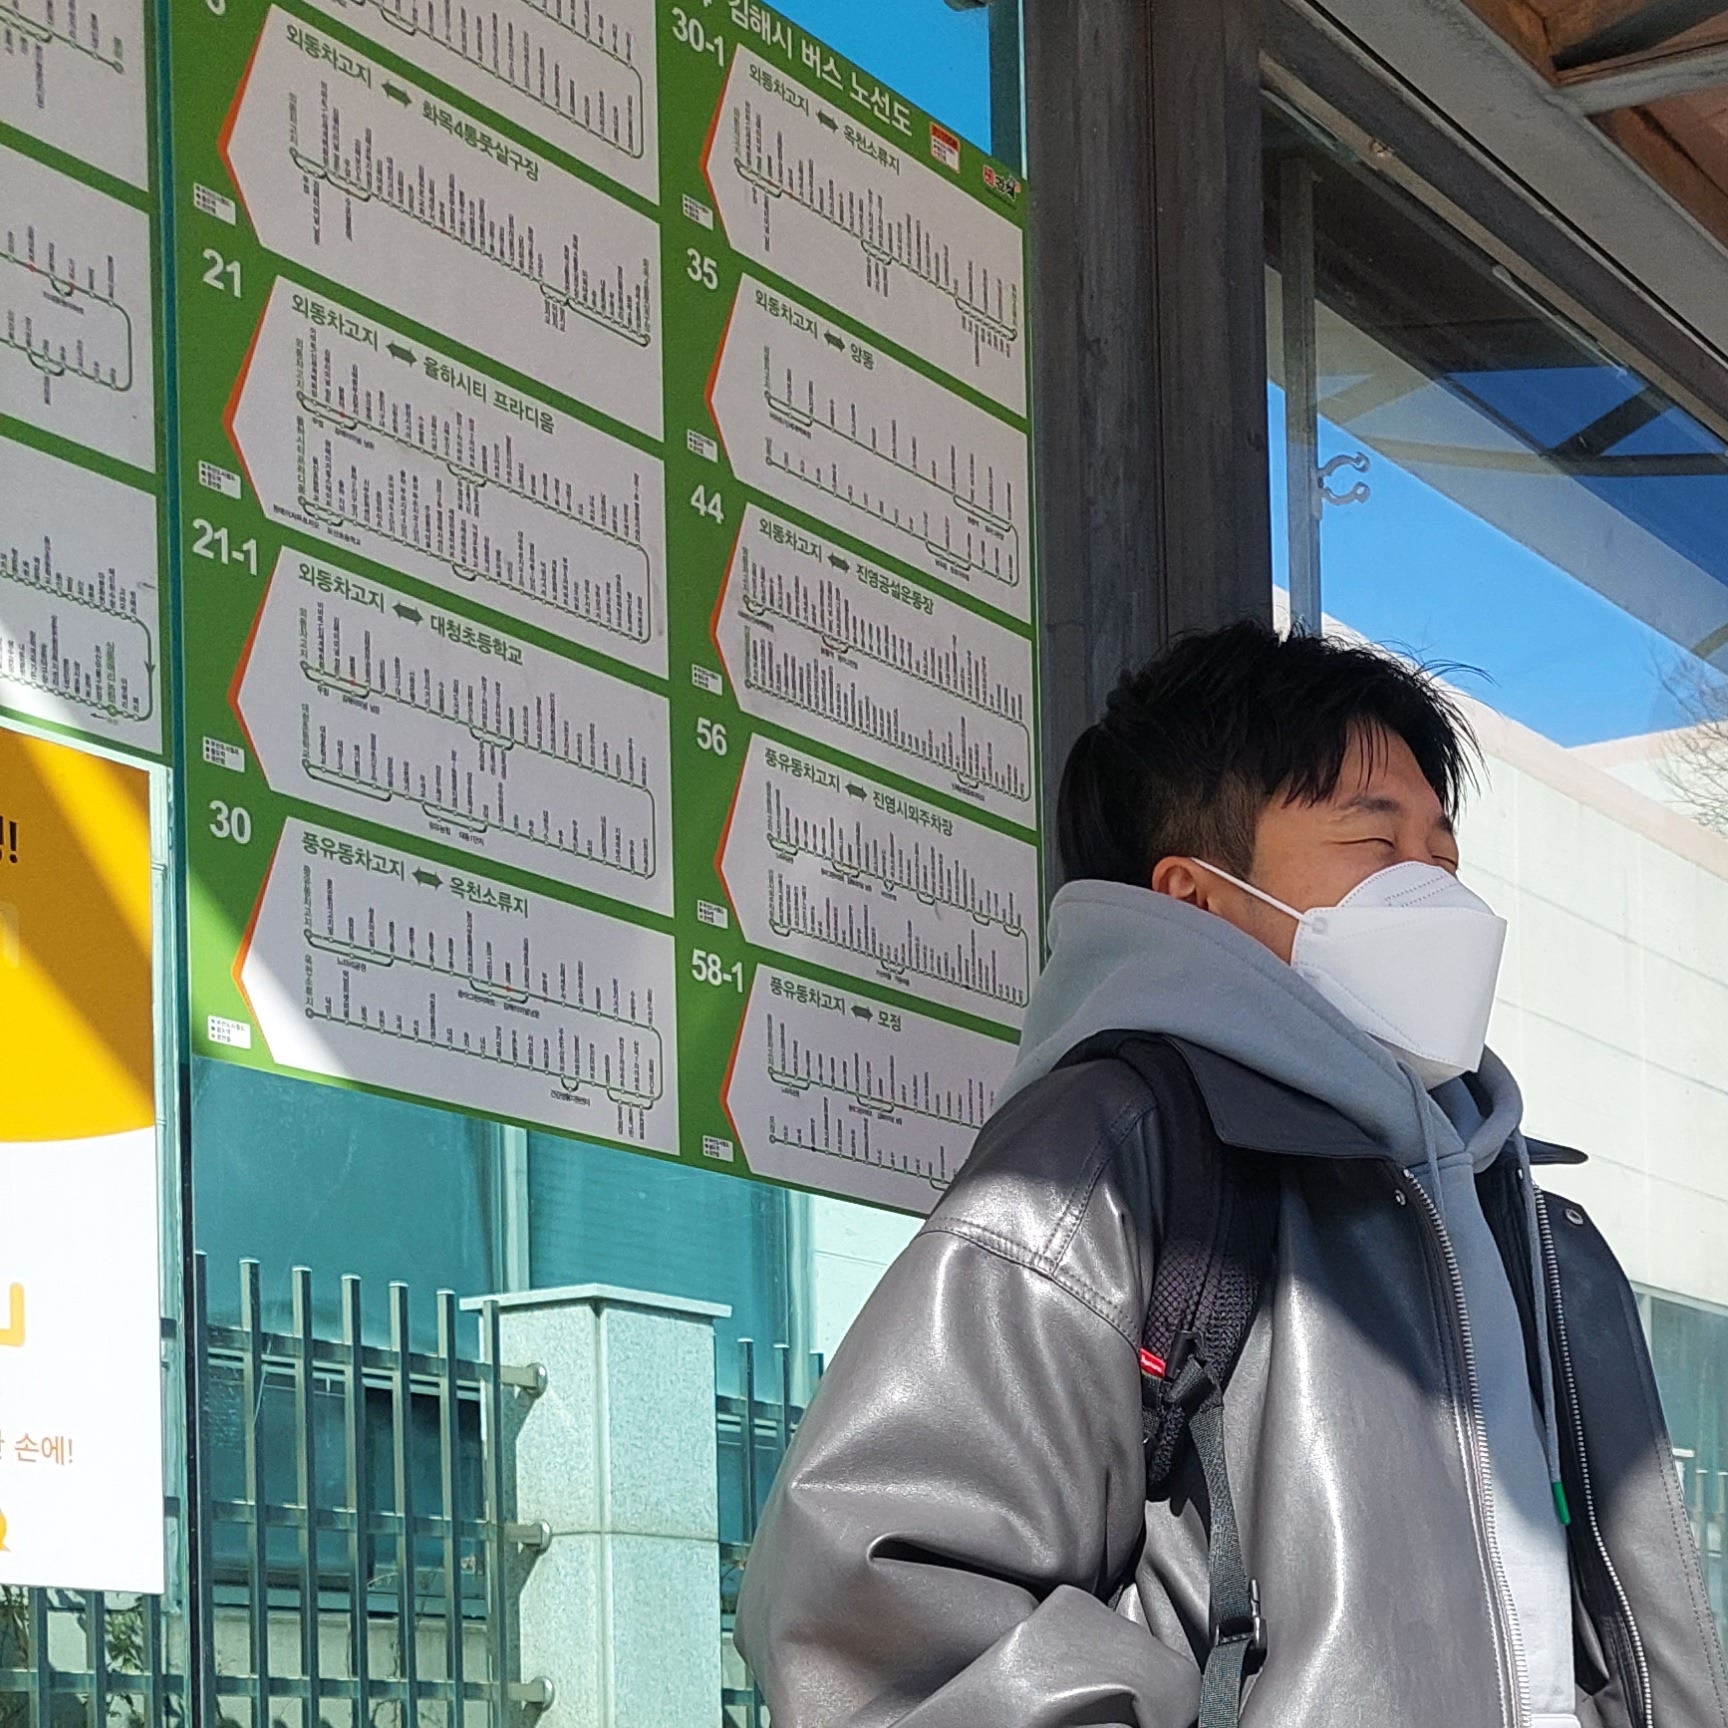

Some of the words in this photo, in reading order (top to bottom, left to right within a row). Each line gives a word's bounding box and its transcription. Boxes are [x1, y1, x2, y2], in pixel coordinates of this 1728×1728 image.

[286, 24, 372, 89] 외동차고지
[671, 7, 724, 67] 30-1
[728, 0, 792, 60] 김해시
[801, 39, 844, 91] 버스
[850, 72, 912, 136] 노선도
[749, 63, 810, 117] 외동차고지
[843, 125, 900, 176] 옥천소류지
[203, 248, 241, 298] 21
[686, 248, 718, 290] 35
[755, 289, 818, 340] 외동차고지
[292, 294, 378, 351] 외동차고지
[423, 356, 486, 403] 율하시티
[493, 390, 554, 435] 프라디움
[691, 484, 724, 525] 44
[192, 518, 257, 576] 21-1
[759, 518, 822, 563] 외동차고지
[856, 563, 934, 616] 진영공설운동장
[299, 563, 384, 614] 외동차고지
[430, 615, 523, 666] 대청초등학교
[696, 716, 727, 756] 56
[765, 747, 841, 793] 풍유동차고지
[873, 790, 953, 837] 진영시외주차장
[209, 800, 251, 844] 30
[302, 831, 404, 881] 풍유동차고지
[450, 876, 528, 918] 옥천소류지
[691, 948, 743, 993] 58-1
[770, 976, 846, 1015] 풍유동차고지
[877, 1010, 902, 1032] 모정
[15, 1433, 73, 1465] 손에!
